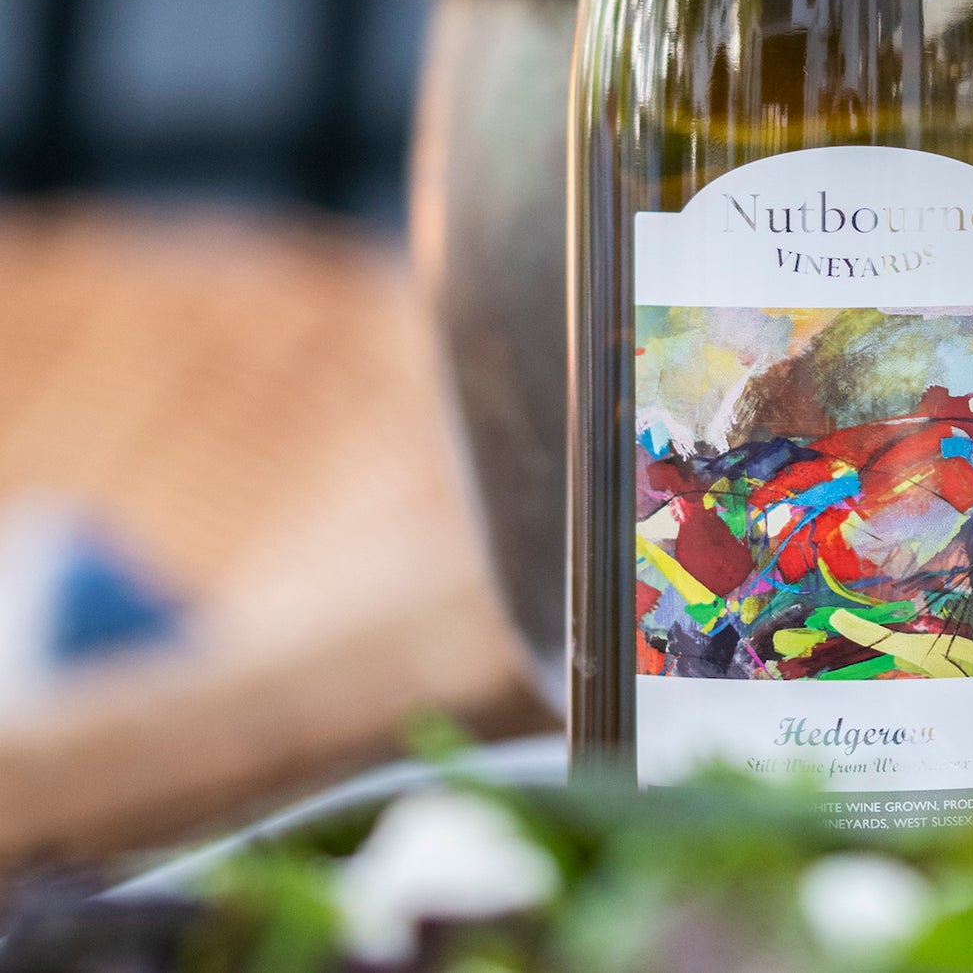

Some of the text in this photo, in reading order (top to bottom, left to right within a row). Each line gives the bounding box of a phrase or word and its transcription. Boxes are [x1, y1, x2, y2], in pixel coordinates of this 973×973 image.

[776, 243, 937, 278] VINEYARDS
[774, 717, 936, 756] Hedgerow
[745, 757, 776, 773] Still
[829, 758, 867, 778] from
[845, 802, 881, 813] WINE
[893, 817, 928, 828] WEST
